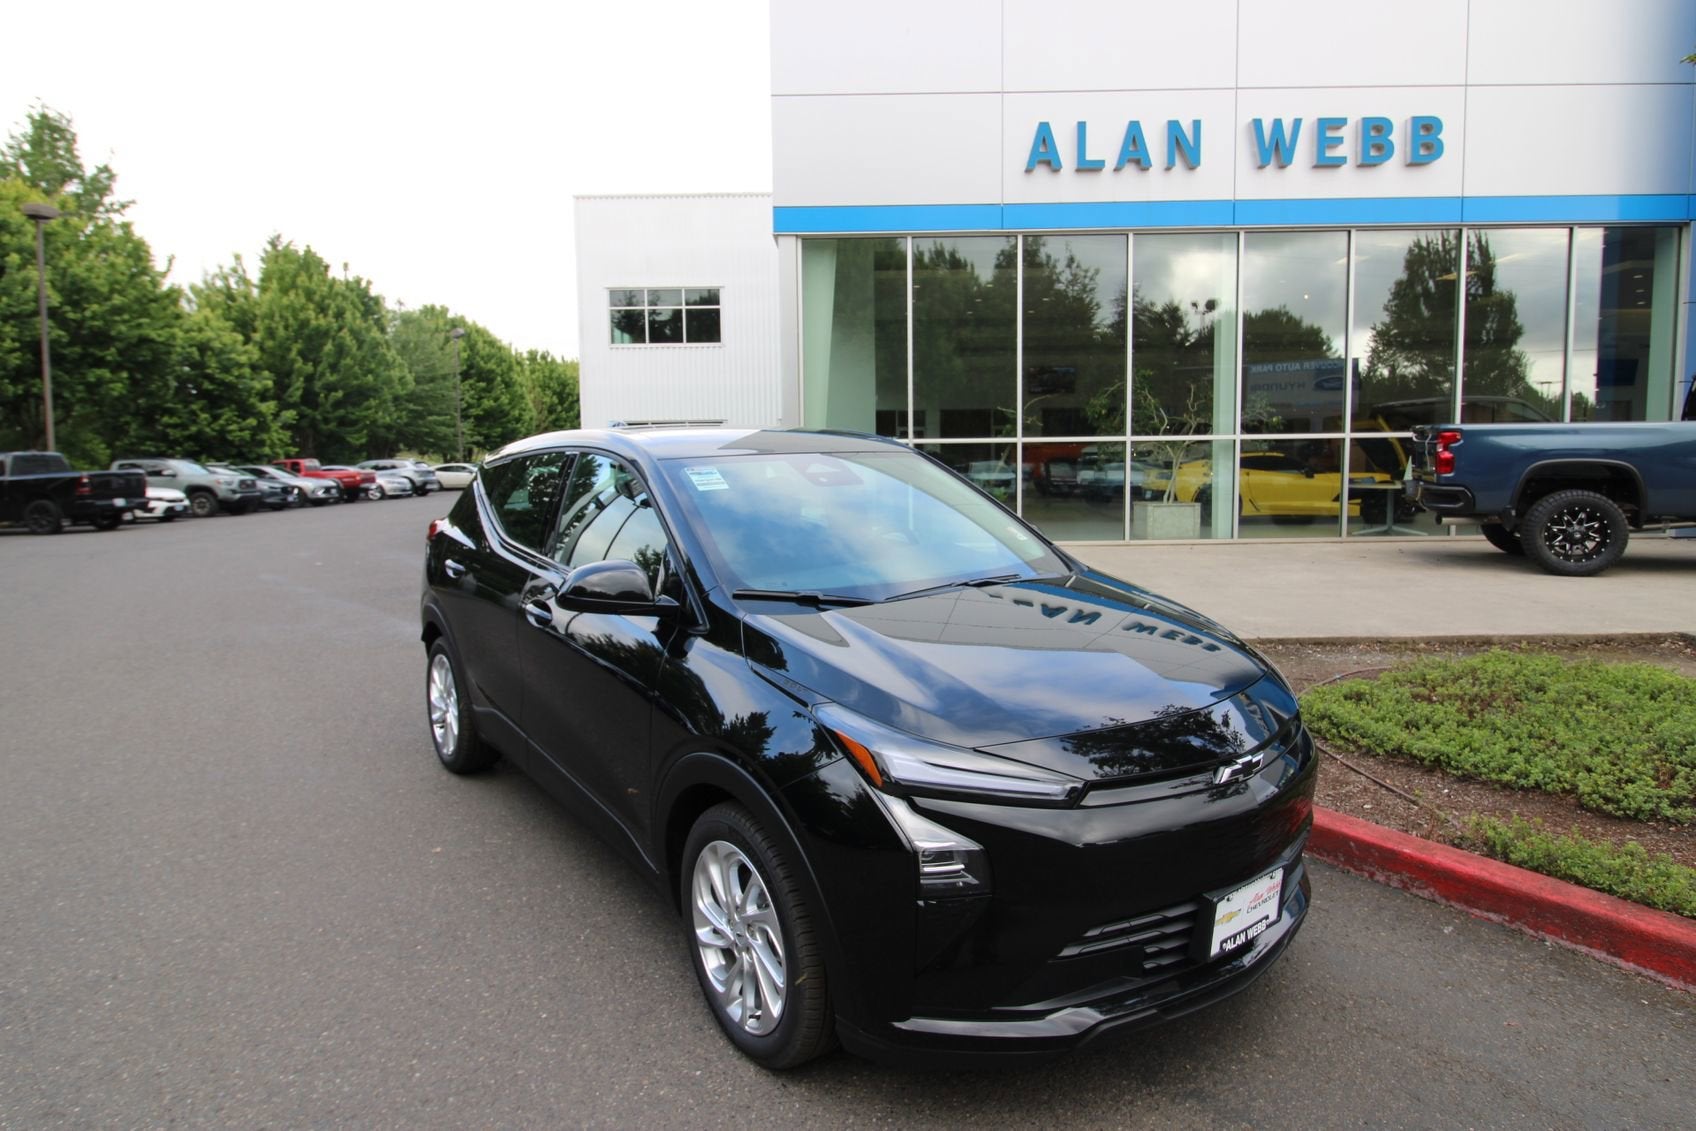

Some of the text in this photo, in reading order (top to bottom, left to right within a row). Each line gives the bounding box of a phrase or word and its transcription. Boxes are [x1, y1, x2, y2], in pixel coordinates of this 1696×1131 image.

[1025, 115, 1445, 173] ALAN WEBB
[1246, 890, 1280, 914] CHEVROLET
[1225, 919, 1267, 952] ALAN WEBB
